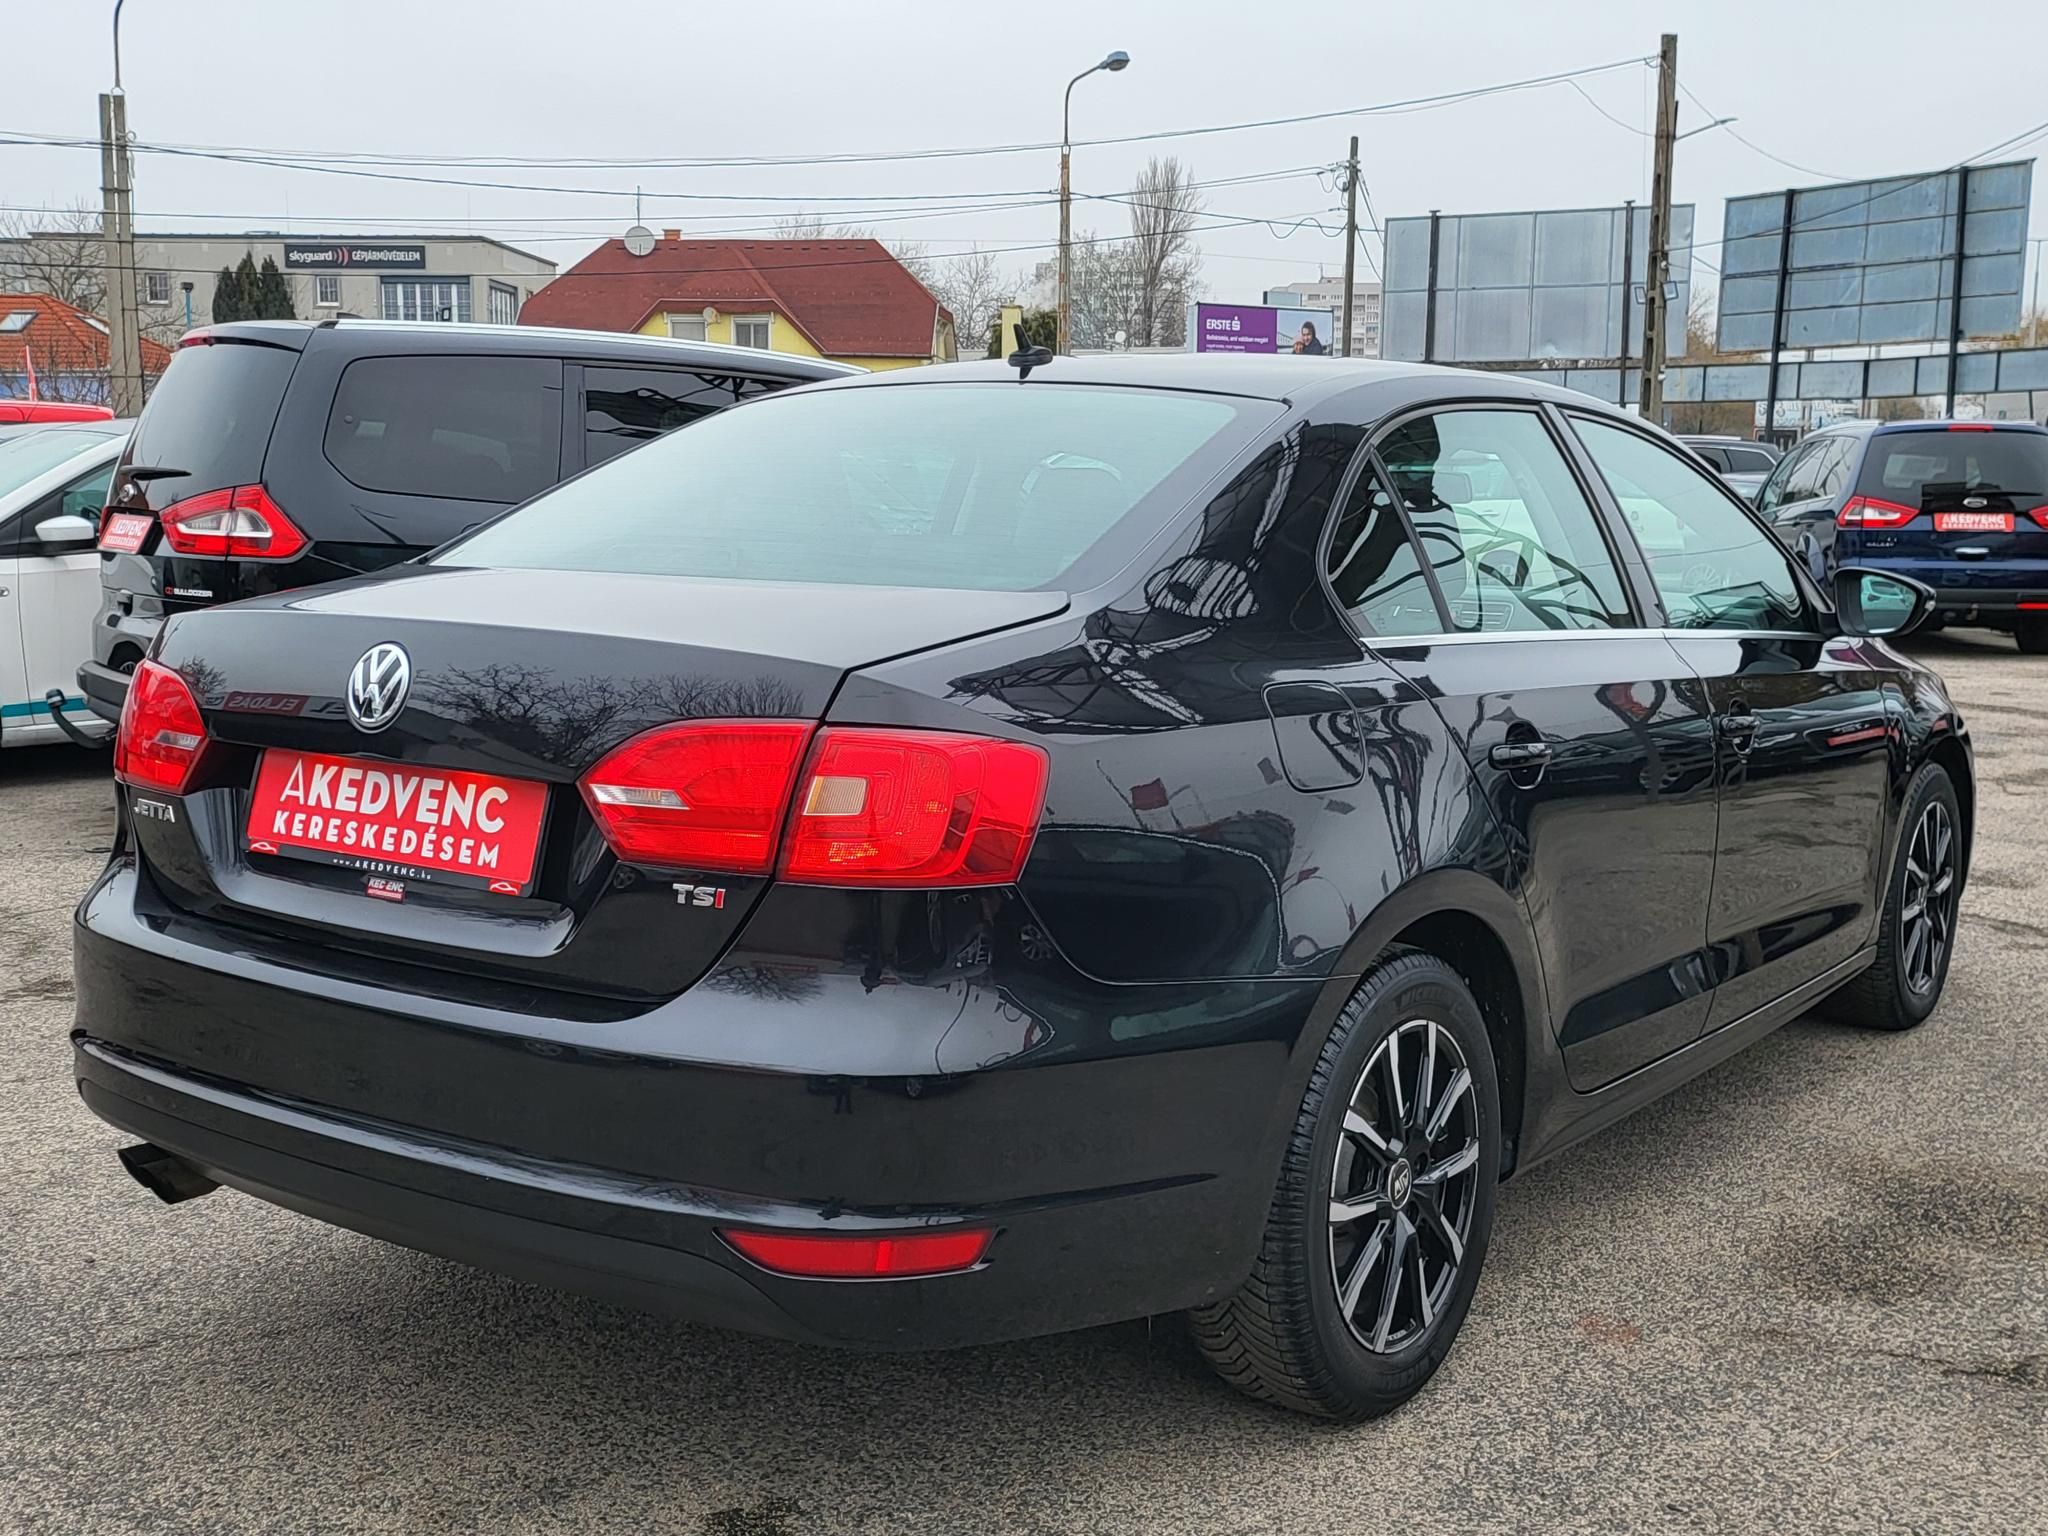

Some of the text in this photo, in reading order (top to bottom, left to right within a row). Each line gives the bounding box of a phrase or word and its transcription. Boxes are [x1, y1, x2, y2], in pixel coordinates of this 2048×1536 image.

[289, 250, 332, 262] skyguard
[1206, 318, 1231, 330] ERSTE
[279, 757, 510, 834] AKEDVENC
[133, 798, 176, 823] JETTA
[272, 809, 500, 869] KERESKEDÉSEM
[672, 883, 726, 909] TSI
